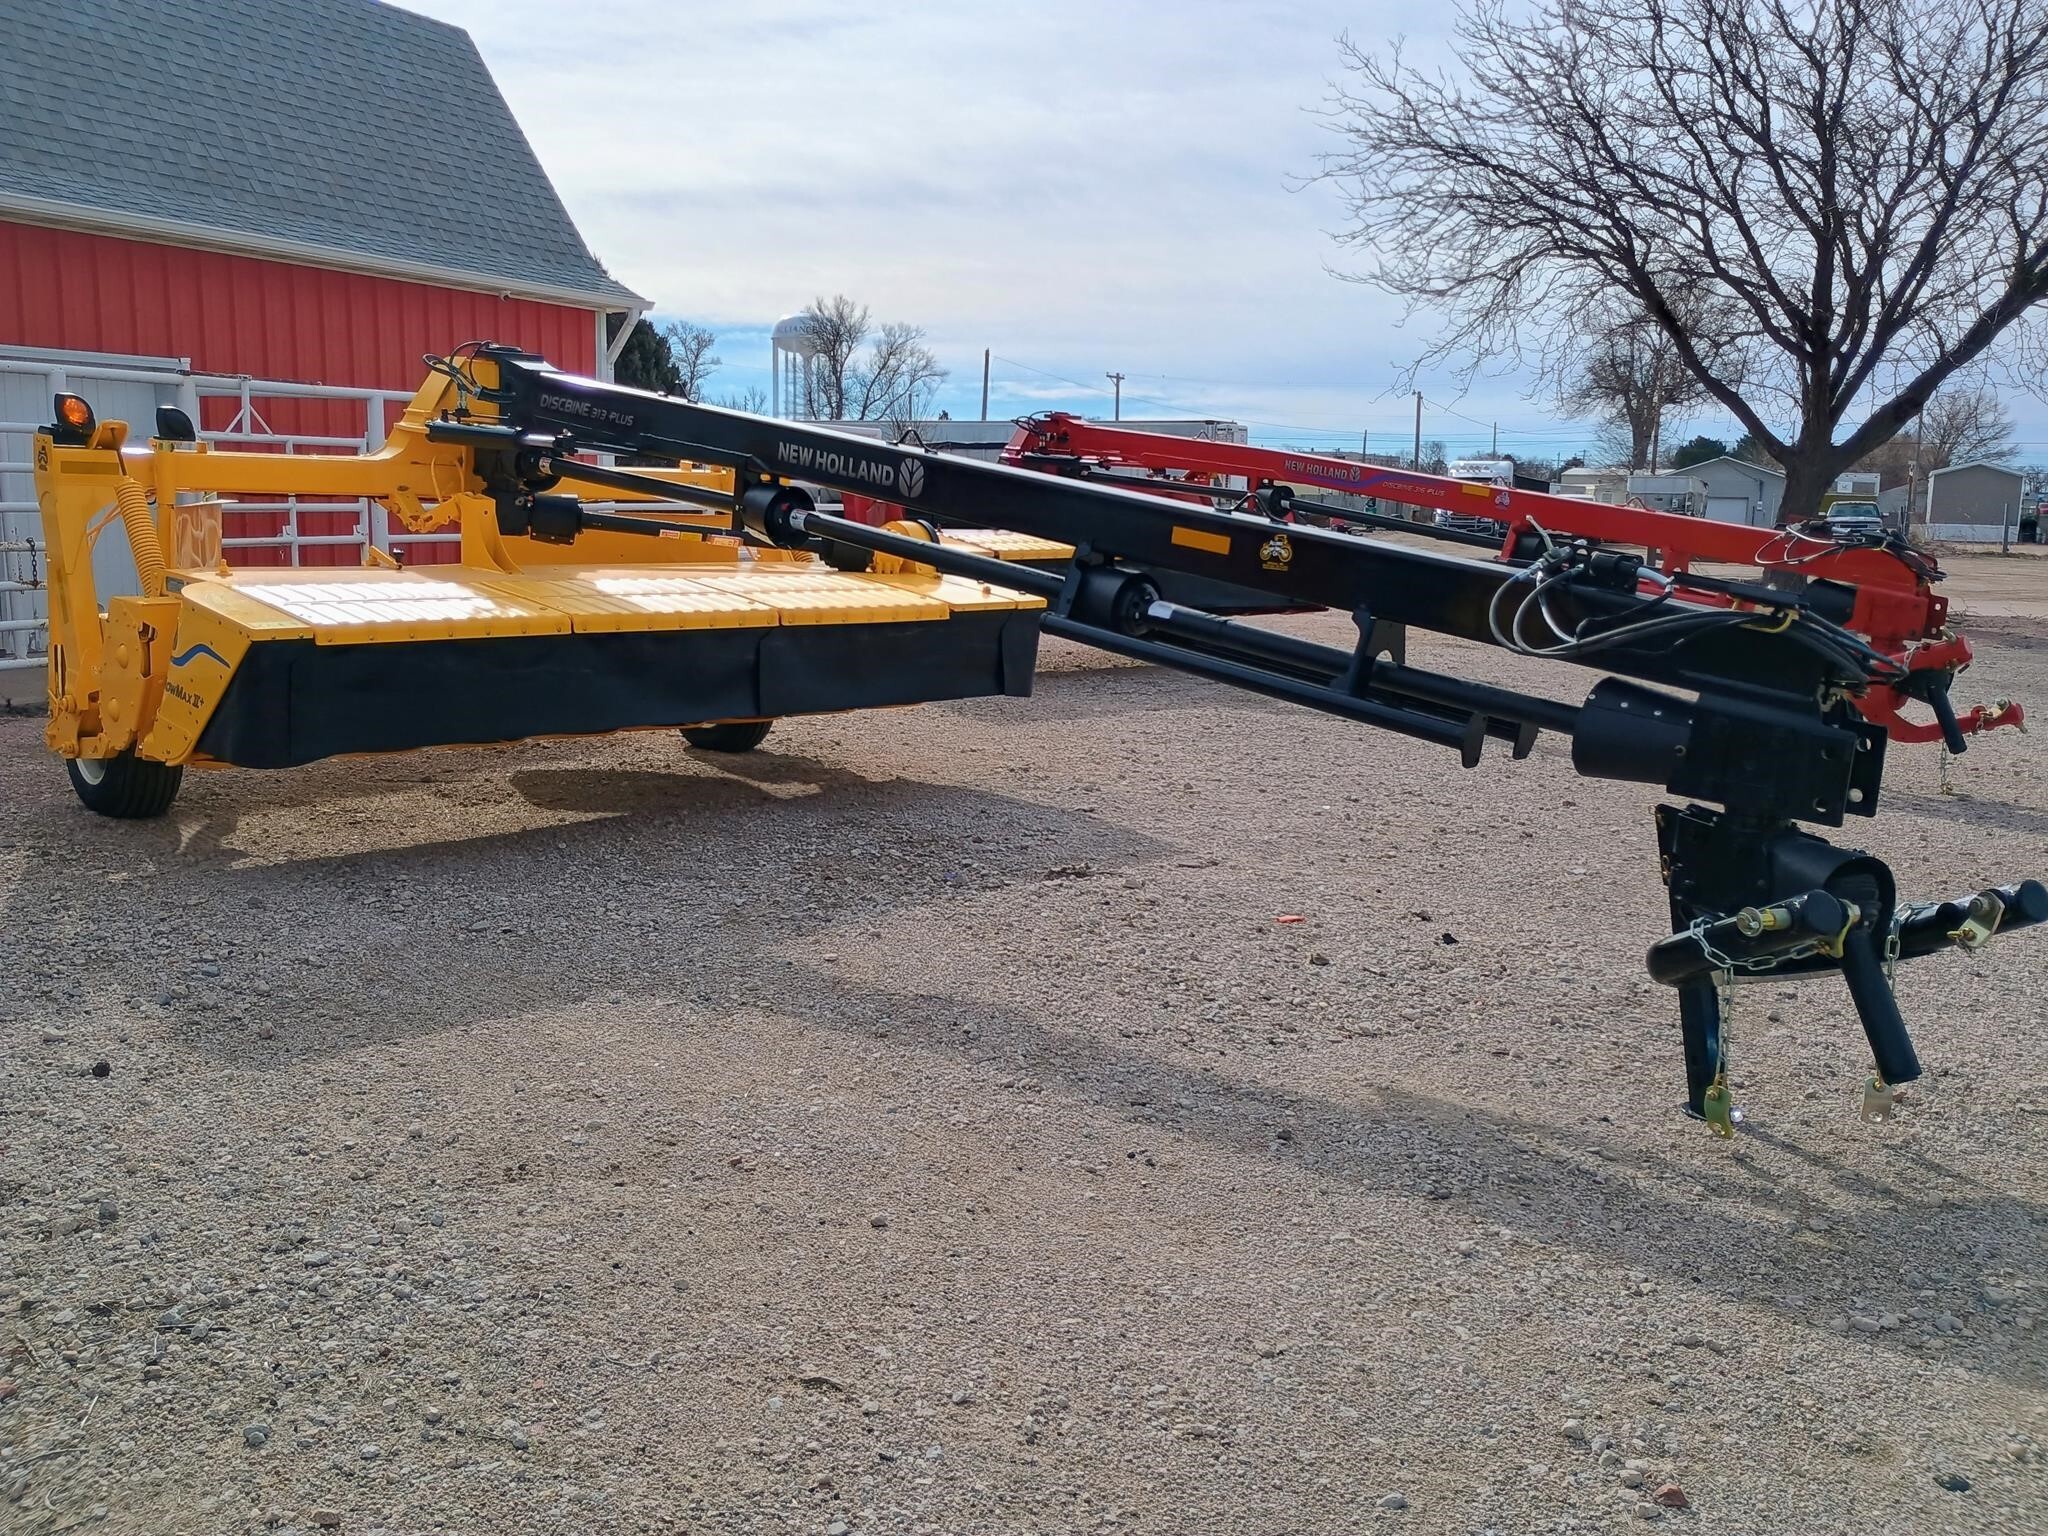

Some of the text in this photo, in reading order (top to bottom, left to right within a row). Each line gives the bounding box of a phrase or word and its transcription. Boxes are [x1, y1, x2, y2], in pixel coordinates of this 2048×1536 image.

[540, 394, 634, 426] DISCBINE 313 PLUS
[778, 441, 895, 486] NEW HOLLAND
[1284, 459, 1348, 480] NEW HOLLAND
